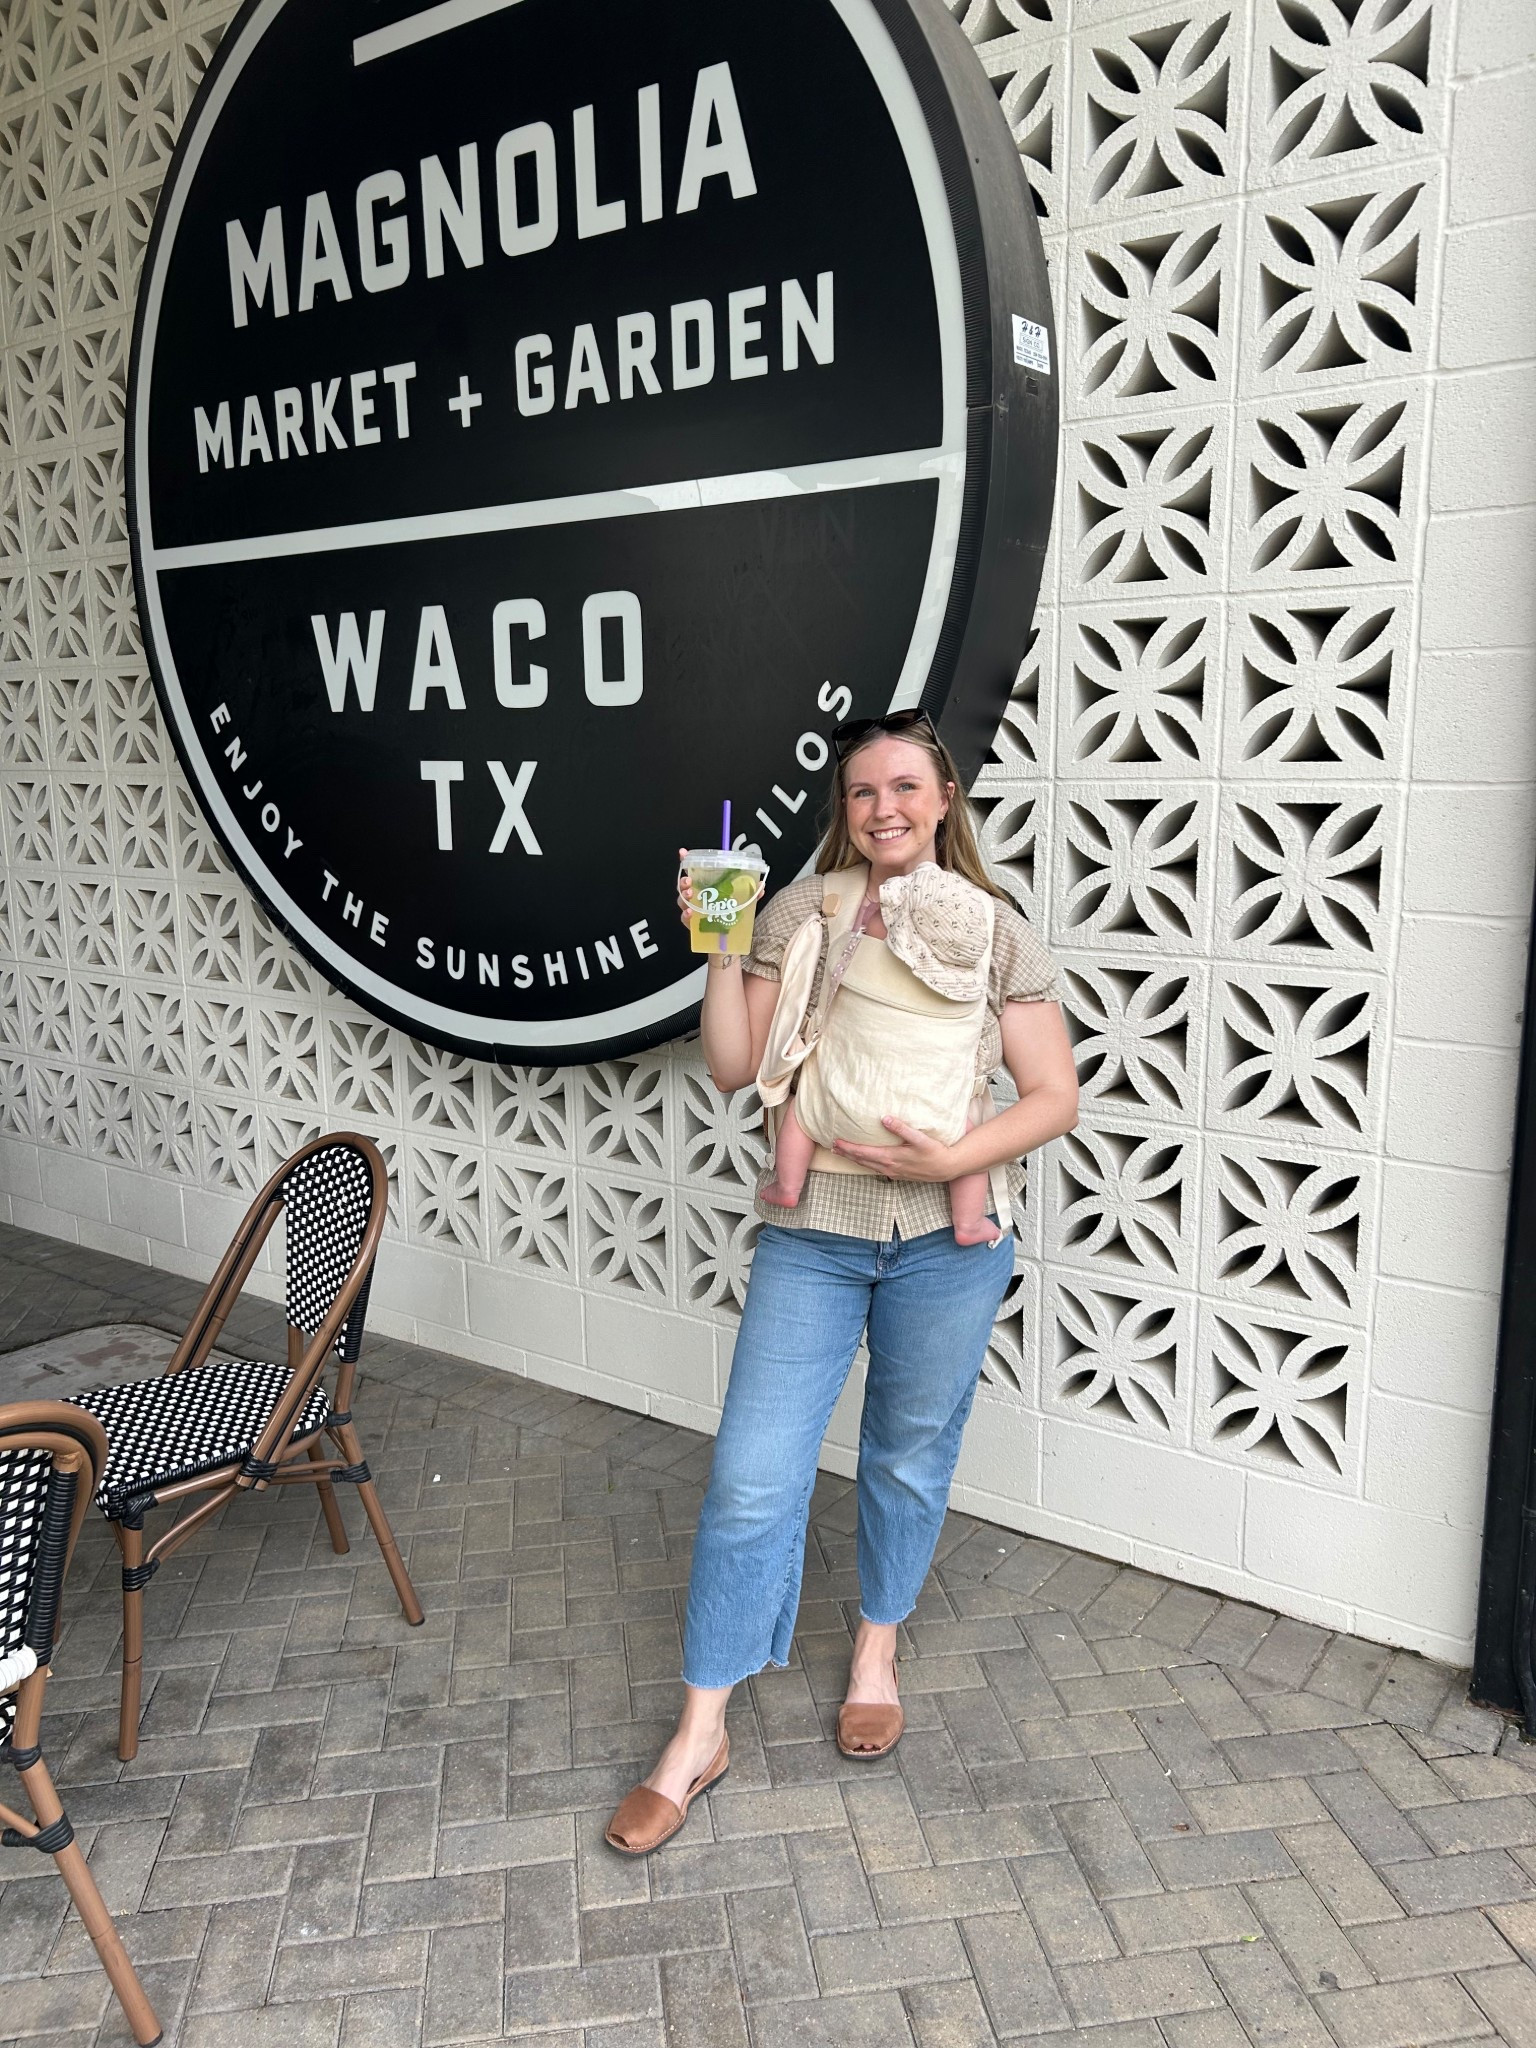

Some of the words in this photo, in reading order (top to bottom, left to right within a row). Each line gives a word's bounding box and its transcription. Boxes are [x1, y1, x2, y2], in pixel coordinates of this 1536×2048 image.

[225, 60, 758, 329] MAGNOLIA
[193, 361, 417, 474] MARKET
[448, 375, 483, 428] +
[514, 270, 835, 417] GARDEN
[310, 590, 644, 713] WACO
[209, 702, 304, 859] ENJOY
[321, 869, 390, 948] THE
[415, 918, 659, 989] SUNSHINE
[731, 680, 853, 859] SILOS
[419, 760, 544, 856] TX
